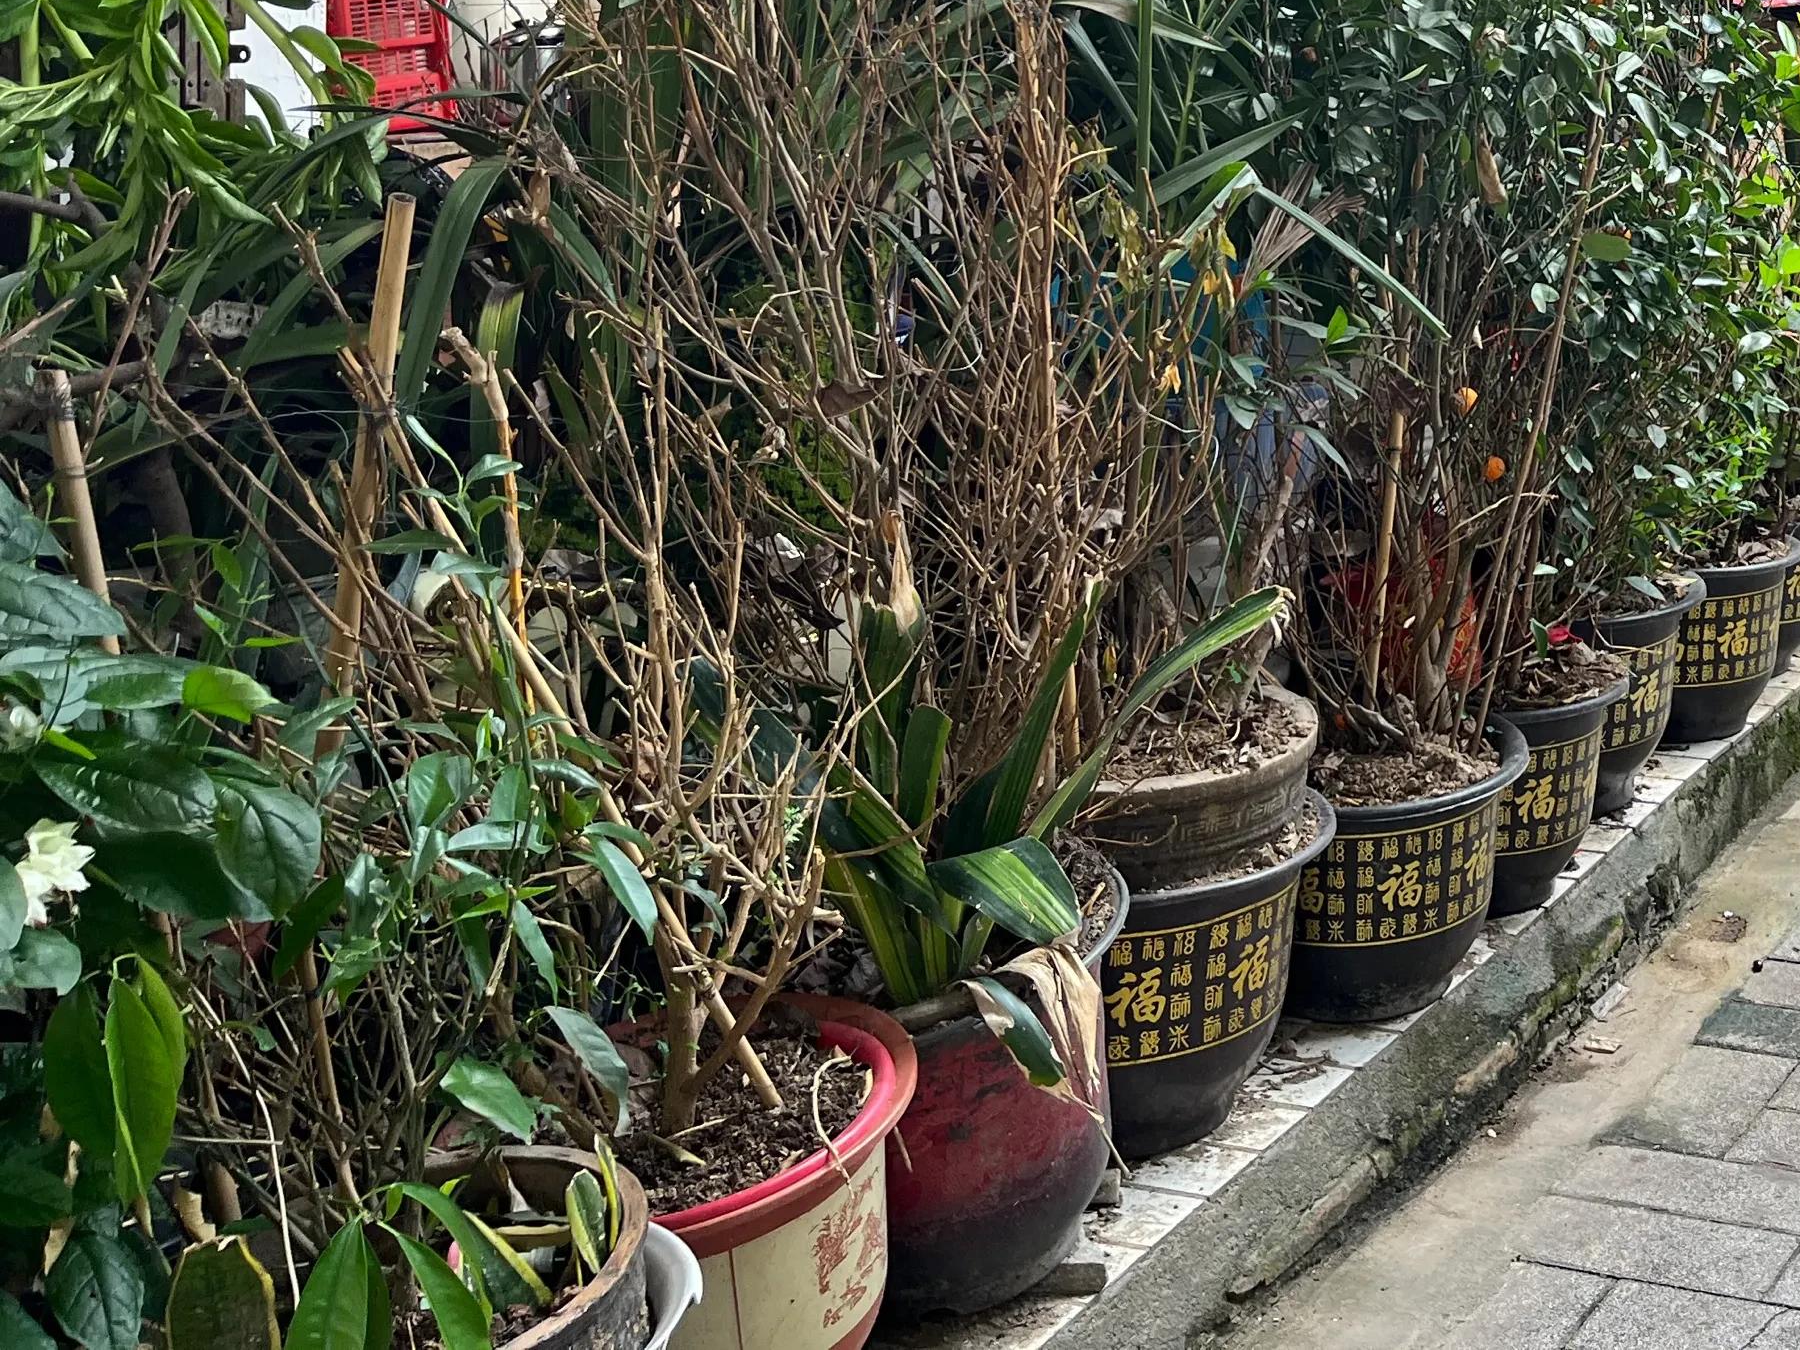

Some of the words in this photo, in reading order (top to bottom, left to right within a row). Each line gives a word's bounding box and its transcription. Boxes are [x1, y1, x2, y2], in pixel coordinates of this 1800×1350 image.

[1717, 618, 1749, 659] 福
[1630, 668, 1660, 718] 福
[1515, 774, 1556, 824] 福
[1377, 860, 1424, 912] 福
[1228, 934, 1270, 1000] 福
[1104, 966, 1167, 1029] 福
